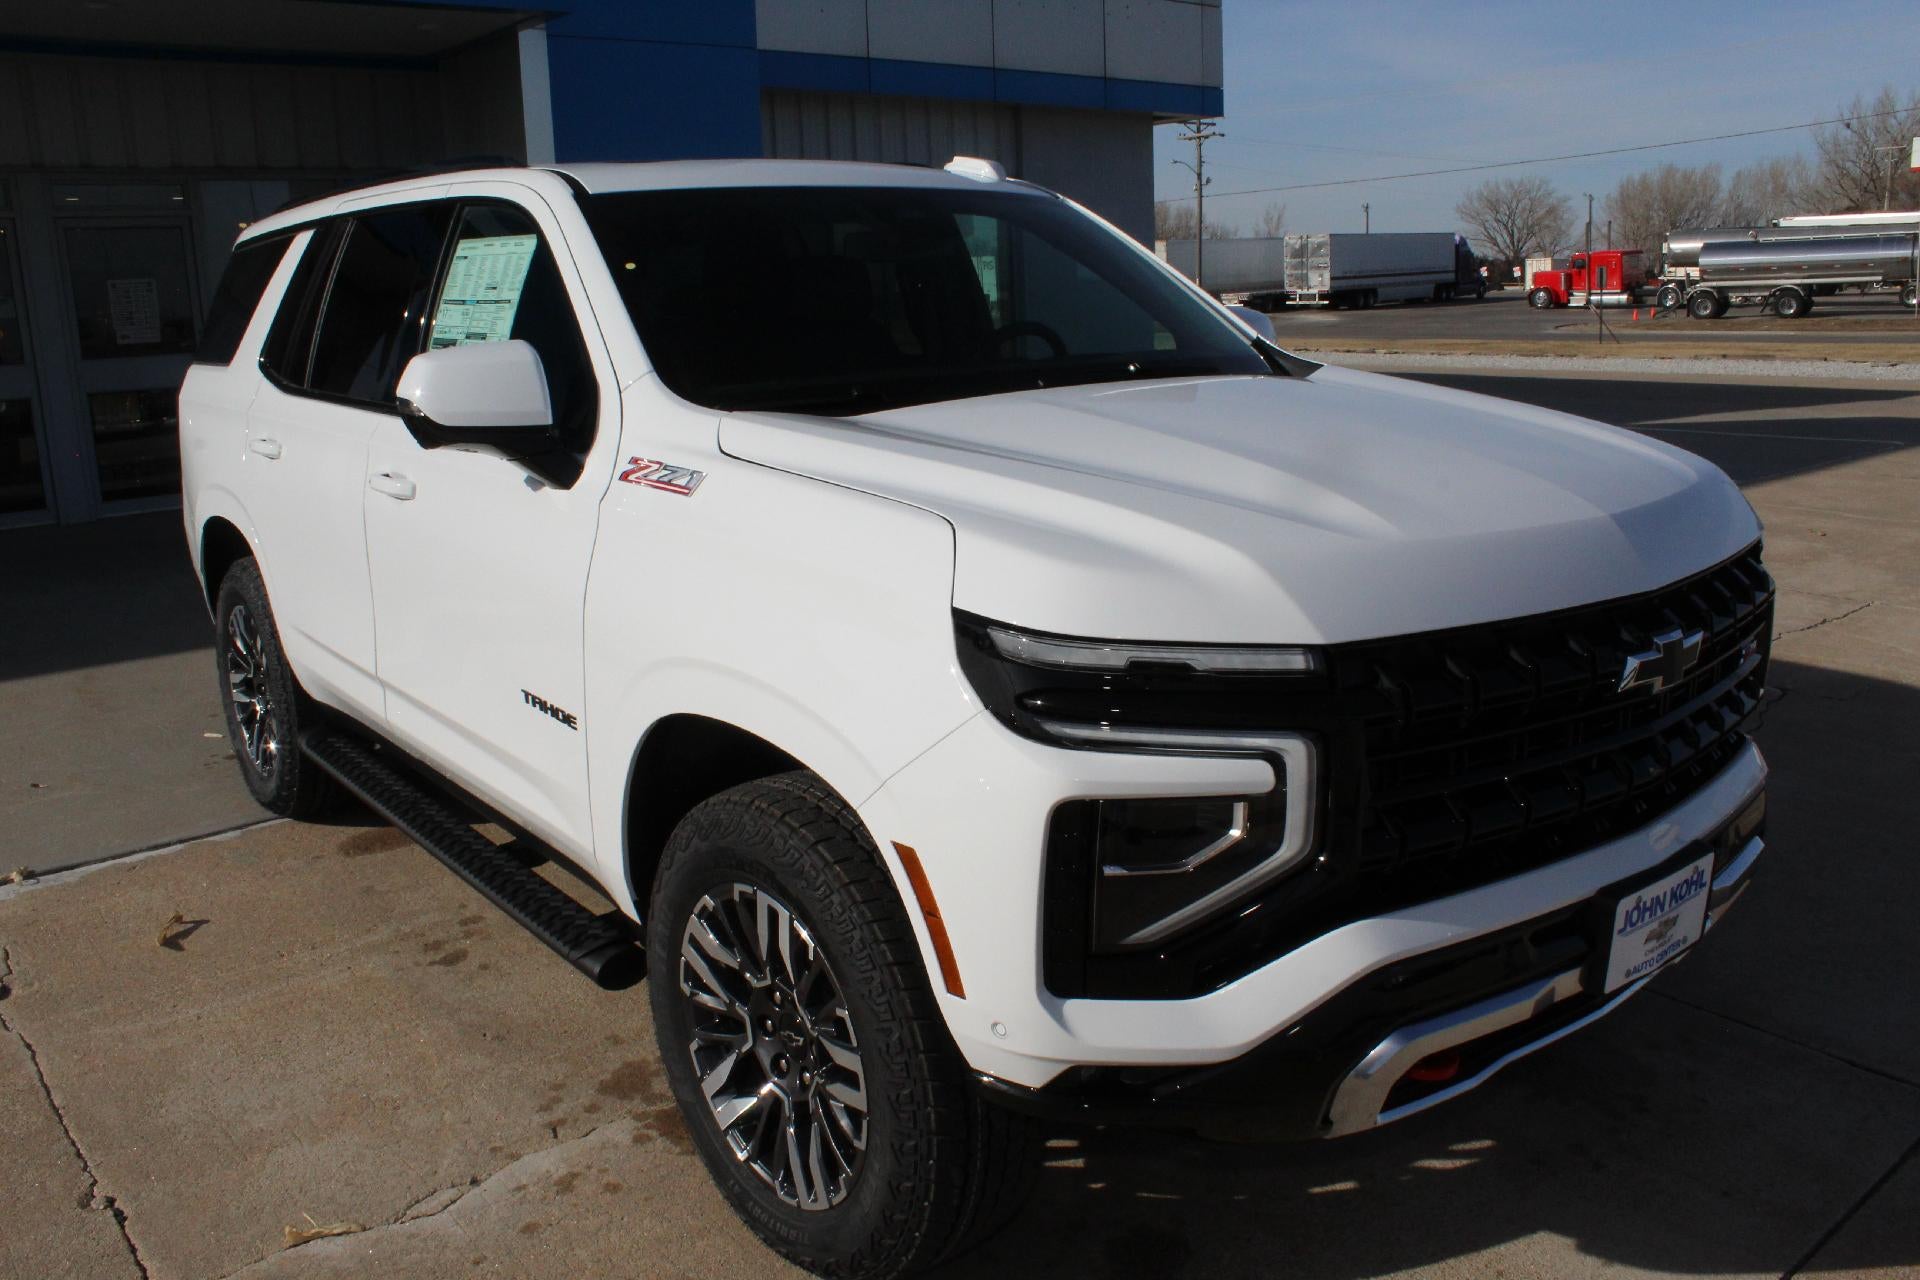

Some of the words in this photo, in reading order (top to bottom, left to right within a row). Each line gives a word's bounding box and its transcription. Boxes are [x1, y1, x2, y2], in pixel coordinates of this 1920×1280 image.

[618, 456, 708, 497] Z71
[521, 689, 578, 731] TAHOE
[1617, 891, 1667, 935] JOHN
[1668, 869, 1707, 908] KOHL
[1631, 957, 1655, 975] AUTO
[1655, 938, 1681, 964] CENTER
